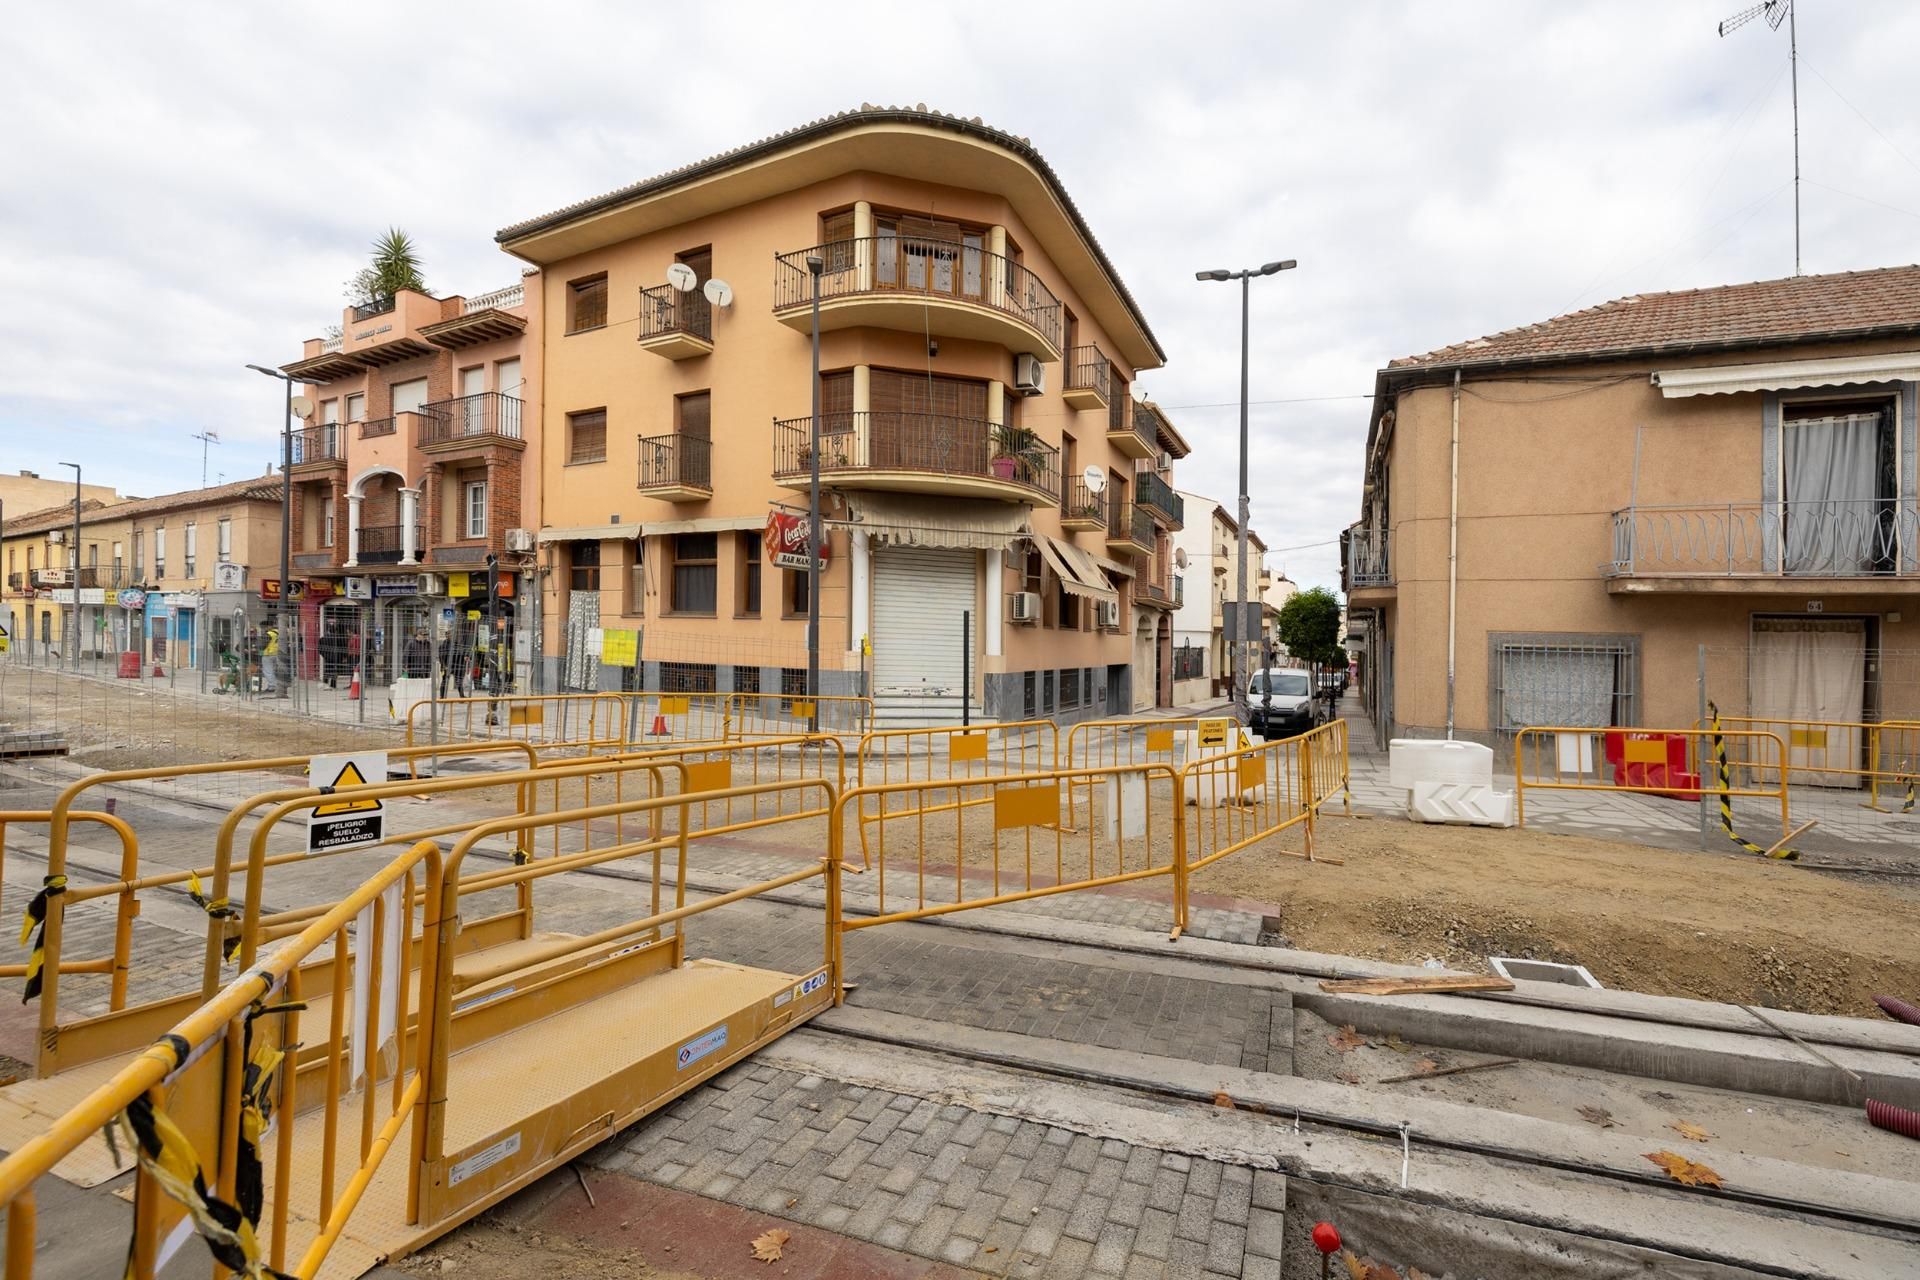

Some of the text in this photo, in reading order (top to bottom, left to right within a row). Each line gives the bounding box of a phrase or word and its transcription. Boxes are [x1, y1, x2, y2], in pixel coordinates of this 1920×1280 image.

[781, 555, 795, 564] BAR
[327, 819, 367, 832] ¡PELIGRO!
[333, 827, 360, 837] SUELO
[318, 832, 374, 847] RESBALADIZO
